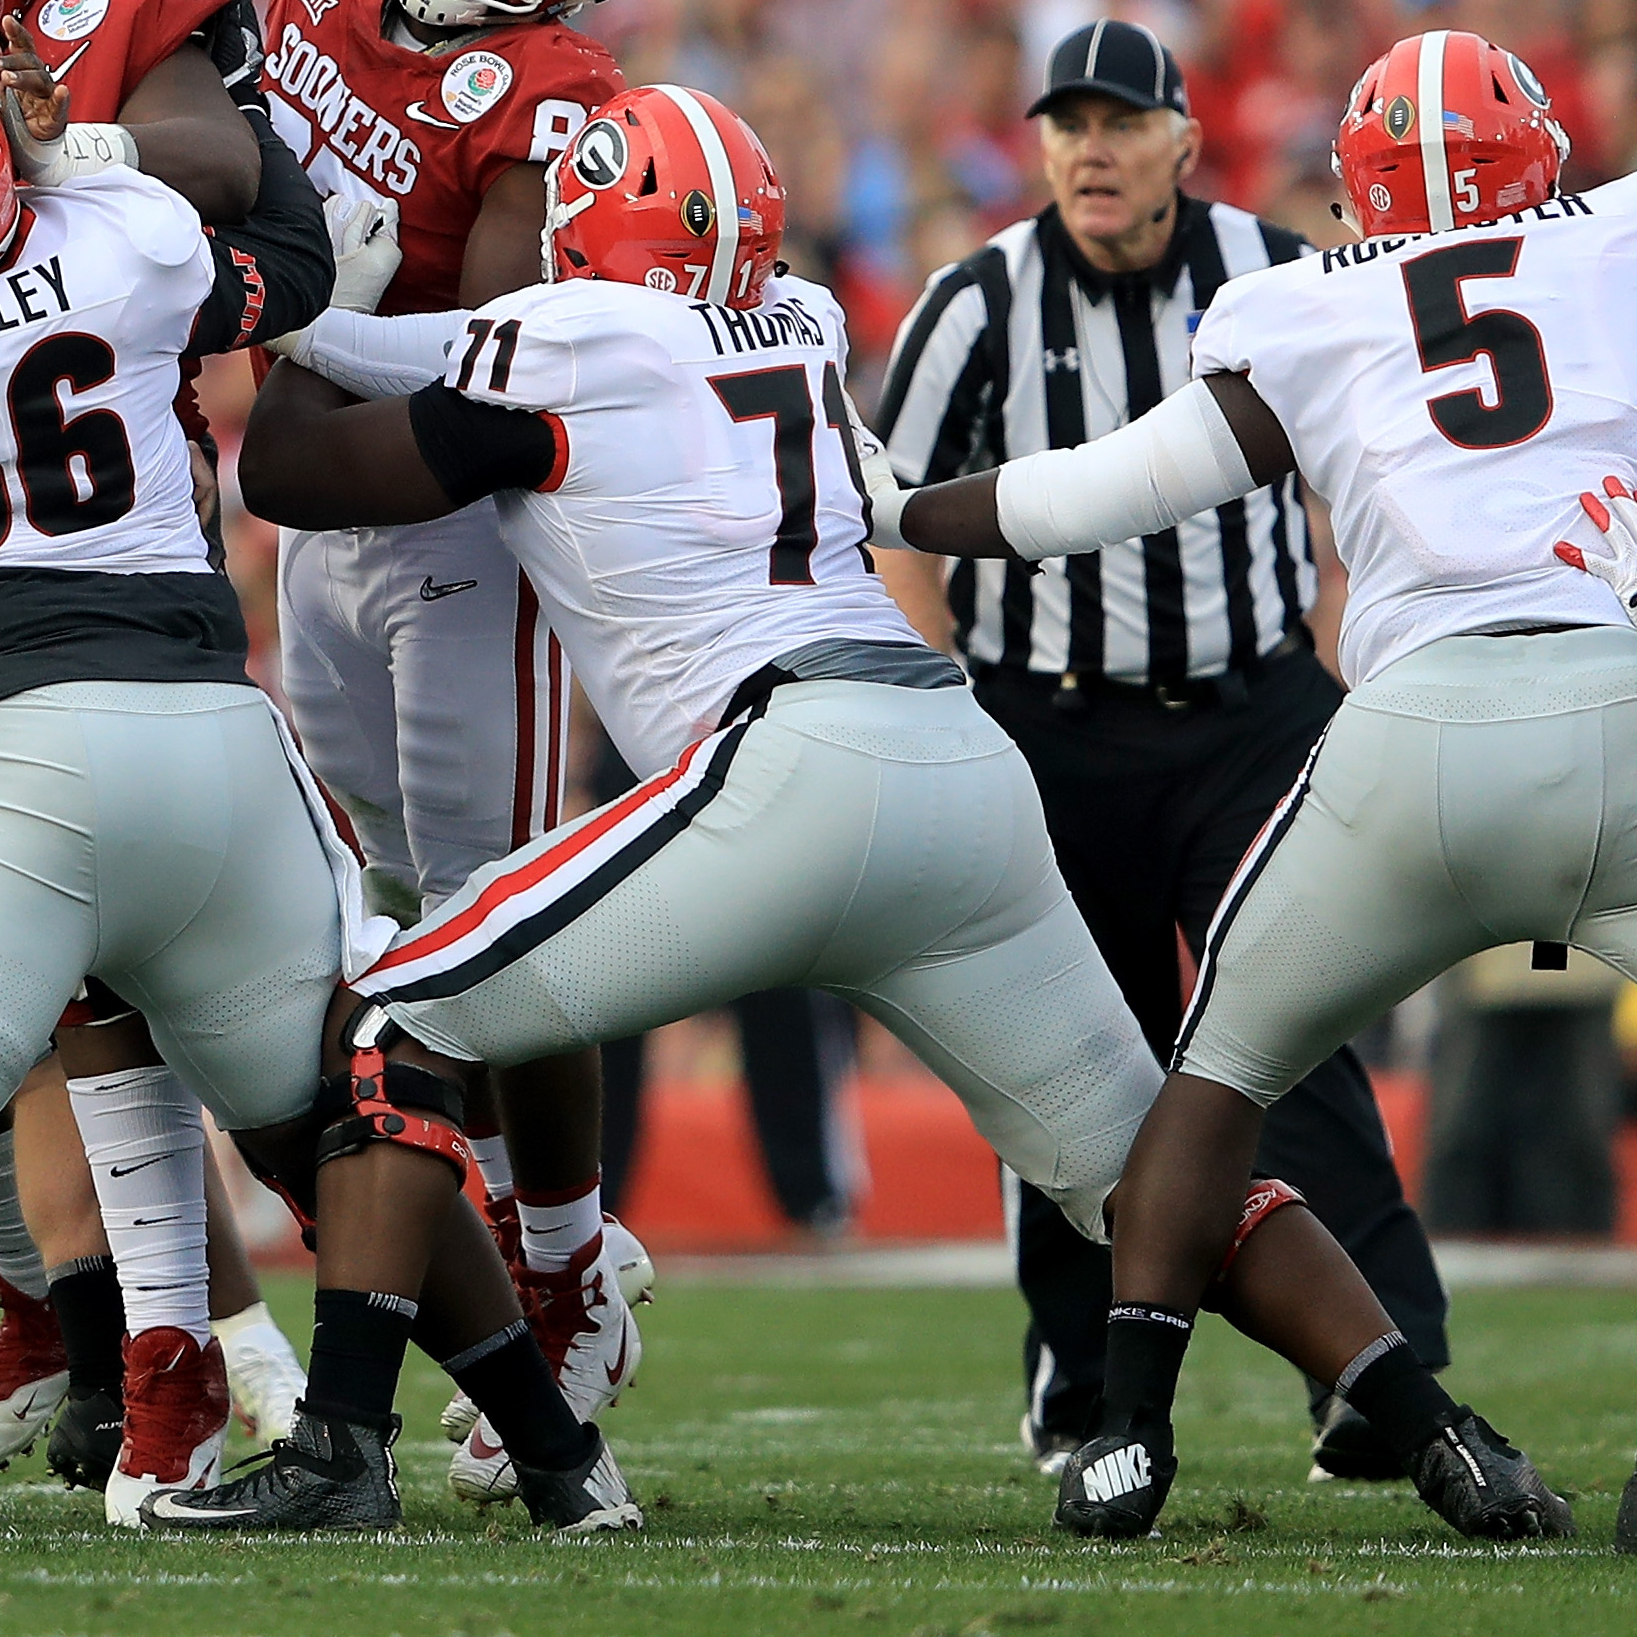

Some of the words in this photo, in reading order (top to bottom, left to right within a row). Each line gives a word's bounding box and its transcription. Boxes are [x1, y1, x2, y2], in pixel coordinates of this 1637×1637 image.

[450, 55, 477, 78] ROSE
[479, 55, 507, 77] BOWL
[265, 22, 421, 195] SOONERS
[1370, 185, 1390, 210] SEC
[1454, 168, 1480, 212] 5
[457, 319, 522, 392] 71
[689, 298, 824, 356] THOMAS
[1400, 235, 1553, 450] 5
[706, 360, 875, 587] 71
[1150, 1311, 1189, 1329] GRIP
[1082, 1443, 1152, 1502] NIKE
